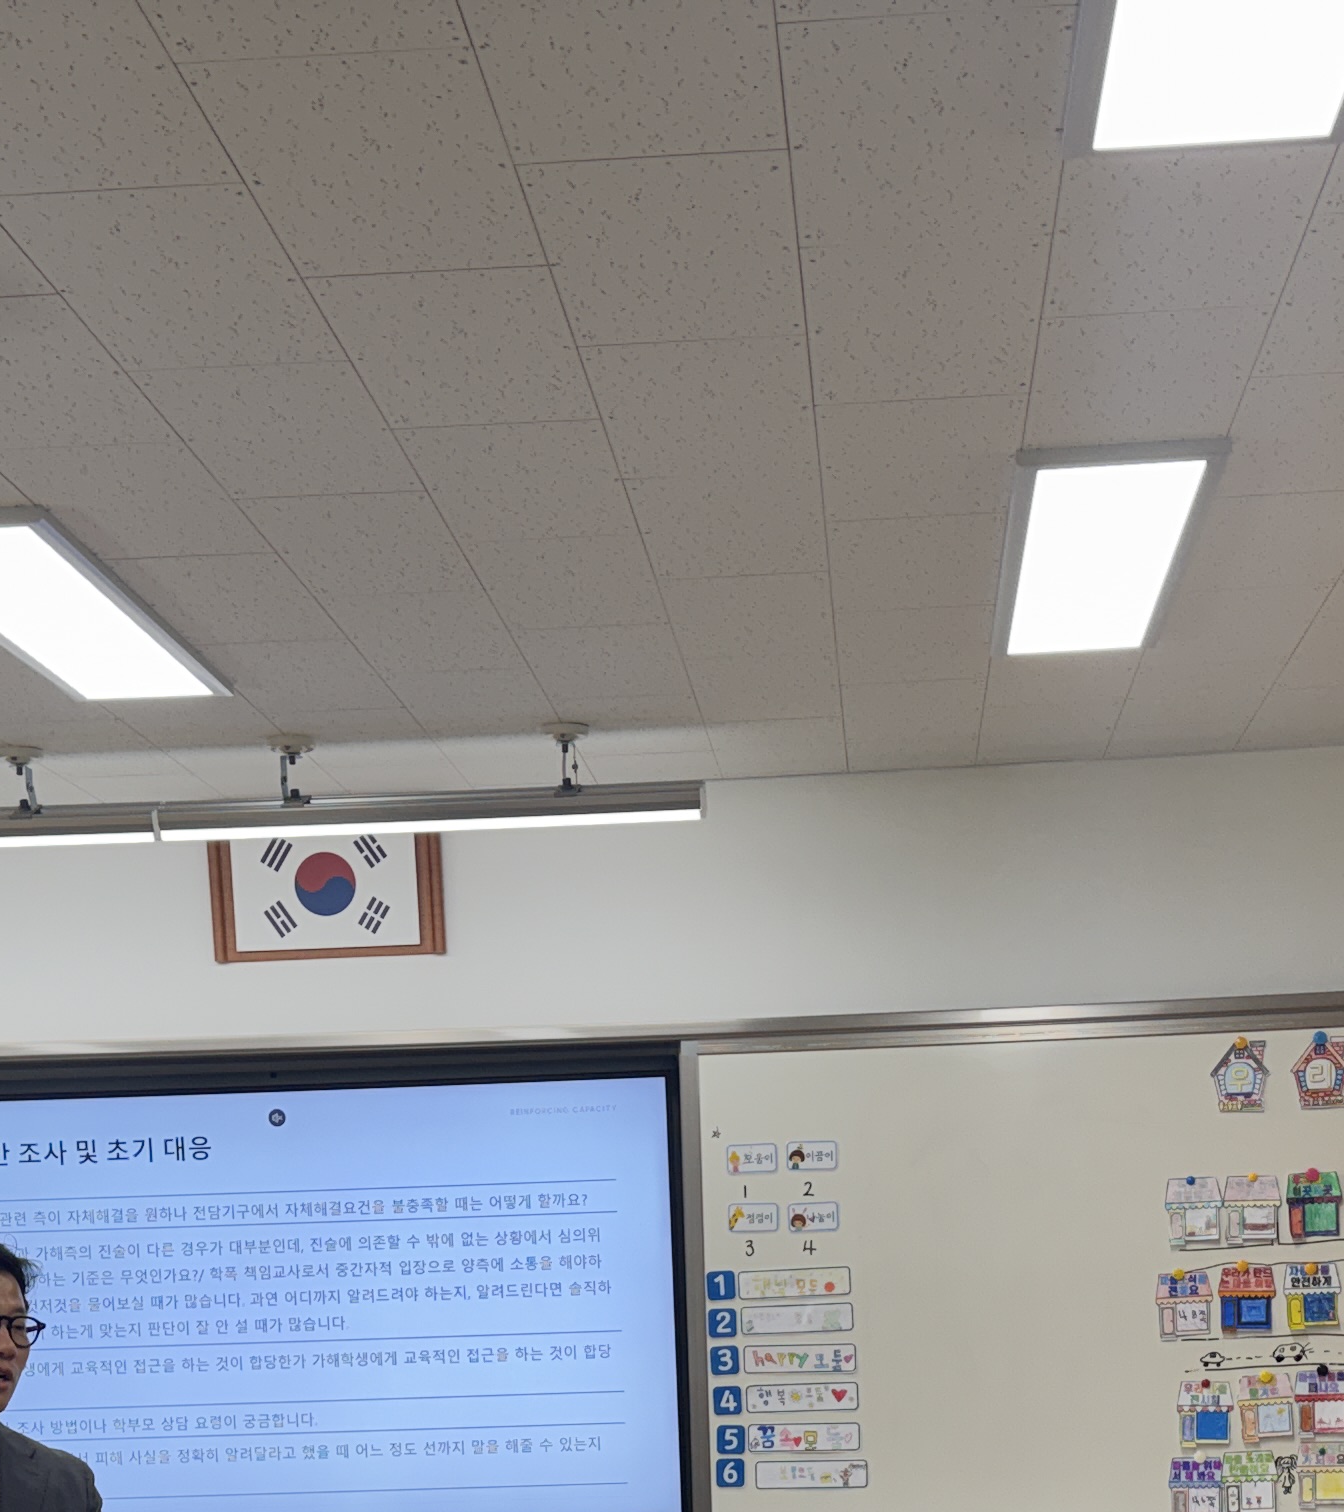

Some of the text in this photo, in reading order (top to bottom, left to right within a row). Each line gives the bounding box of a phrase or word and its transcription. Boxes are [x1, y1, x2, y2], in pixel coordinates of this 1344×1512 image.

[19, 1140, 67, 1166] 조사
[77, 1139, 97, 1165] 및
[107, 1137, 153, 1163] 초기
[164, 1136, 211, 1162] 대응
[743, 1181, 815, 1198] 1 2
[34, 1210, 60, 1226] 측이
[145, 1205, 187, 1222] 원하나
[392, 1196, 448, 1214] 불충족할
[455, 1195, 483, 1212] 때는
[489, 1193, 531, 1210] 어떻게
[538, 1192, 587, 1209] 할까요?
[36, 1244, 92, 1261] 가해측의
[99, 1243, 139, 1260] 진술이
[147, 1241, 174, 1258] 다른
[181, 1240, 223, 1257] 경우가
[310, 1236, 351, 1253] 진술에
[358, 1234, 400, 1251] 의존할
[407, 1234, 420, 1250] 수
[426, 1232, 454, 1249] 밖에
[461, 1231, 488, 1247] 없는
[495, 1228, 551, 1246] 상황에서
[558, 1227, 600, 1244] 심의위
[745, 1240, 817, 1257] 3 4
[73, 1270, 114, 1287] 기준은
[210, 1266, 237, 1282] 학폭
[336, 1260, 391, 1278] 중간자적
[399, 1259, 456, 1276] 입장으로
[462, 1256, 503, 1273] 양측에
[510, 1255, 552, 1271] 소통을
[559, 1253, 602, 1270] 해야하
[88, 1295, 143, 1312] 물어보실
[151, 1294, 178, 1310] 때가
[250, 1291, 277, 1308] 과연
[285, 1288, 340, 1306] 어디까지
[425, 1285, 470, 1302] 하는지,
[569, 1280, 611, 1297] 솔직하
[713, 1274, 725, 1297] 1
[51, 1324, 93, 1340] 하는게
[100, 1321, 141, 1338] 맞는지
[148, 1320, 189, 1337] 판단이
[196, 1319, 209, 1336] 잘
[216, 1319, 228, 1335] 안
[236, 1318, 247, 1334] 설
[255, 1317, 282, 1334] 때가
[715, 1311, 732, 1334] 2
[72, 1359, 126, 1376] 교육적인
[134, 1358, 175, 1374] 접근을
[182, 1357, 209, 1373] 하는
[216, 1355, 243, 1372] 것이
[250, 1354, 306, 1370] 합당한가
[404, 1348, 459, 1365] 교육적인
[467, 1347, 508, 1364] 접근을
[515, 1346, 543, 1362] 하는
[550, 1344, 576, 1361] 것이
[584, 1343, 611, 1360] 합당
[717, 1348, 734, 1372] 3
[720, 1390, 737, 1412] 4
[51, 1418, 107, 1435] 방법이나
[113, 1417, 155, 1433] 학부모
[161, 1415, 188, 1432] 상담
[195, 1415, 236, 1430] 요령이
[724, 1428, 739, 1450] 5
[96, 1451, 122, 1466] 피해
[129, 1449, 171, 1465] 사실을
[178, 1447, 218, 1464] 정확히
[302, 1444, 329, 1460] 했을
[336, 1444, 349, 1459] 때
[356, 1443, 383, 1459] 어느
[390, 1442, 417, 1457] 정도
[424, 1440, 464, 1457] 선까지
[472, 1439, 499, 1455] 말을
[505, 1438, 532, 1454] 해줄
[540, 1437, 553, 1453] 수
[560, 1436, 600, 1453] 있는지
[723, 1461, 738, 1483] 6
